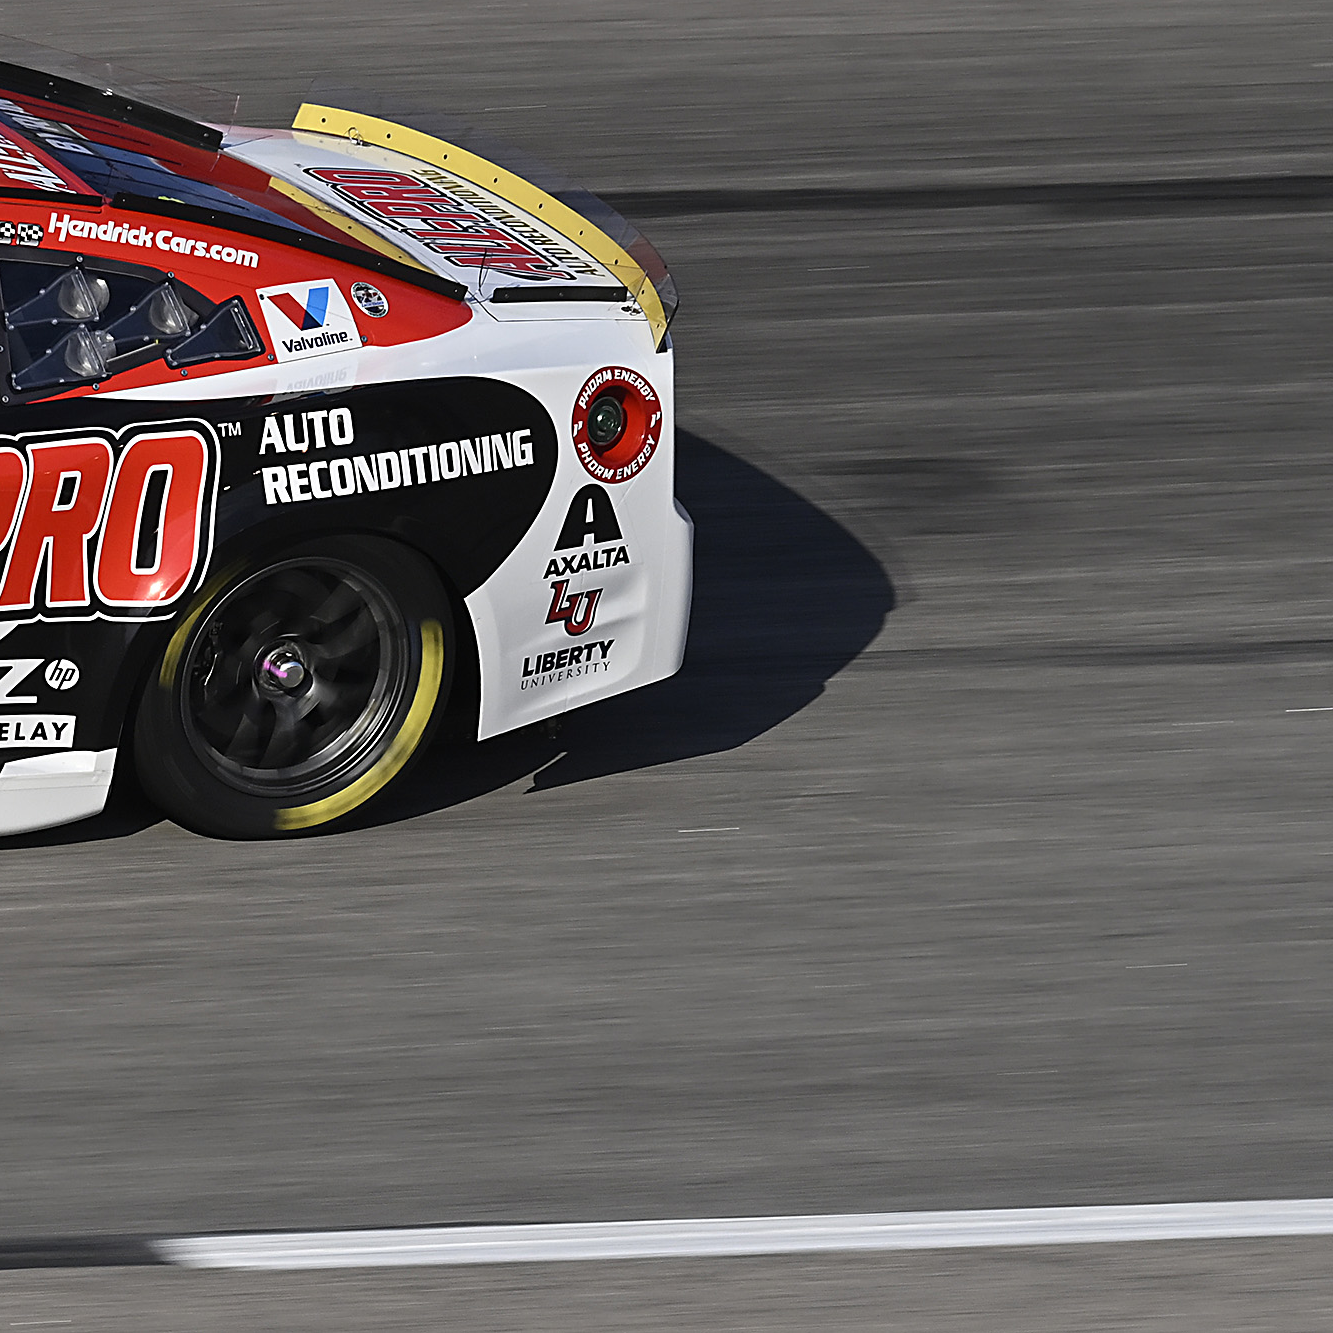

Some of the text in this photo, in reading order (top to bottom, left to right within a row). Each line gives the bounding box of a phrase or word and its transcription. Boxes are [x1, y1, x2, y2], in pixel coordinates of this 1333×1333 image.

[303, 166, 577, 281] ALL-PRO
[281, 331, 350, 354] Valvoline
[578, 369, 656, 410] PHORM ENERGY
[217, 422, 242, 438] TM
[258, 407, 355, 455] AUTO
[261, 428, 535, 506] RECONDITIONING
[577, 434, 656, 481] PHORM ENERGY
[542, 545, 631, 580] AXALTA
[544, 578, 604, 637] LU
[48, 659, 77, 690] hp
[520, 660, 612, 691] UNIVERSITY
[521, 638, 616, 678] LIBERTY
